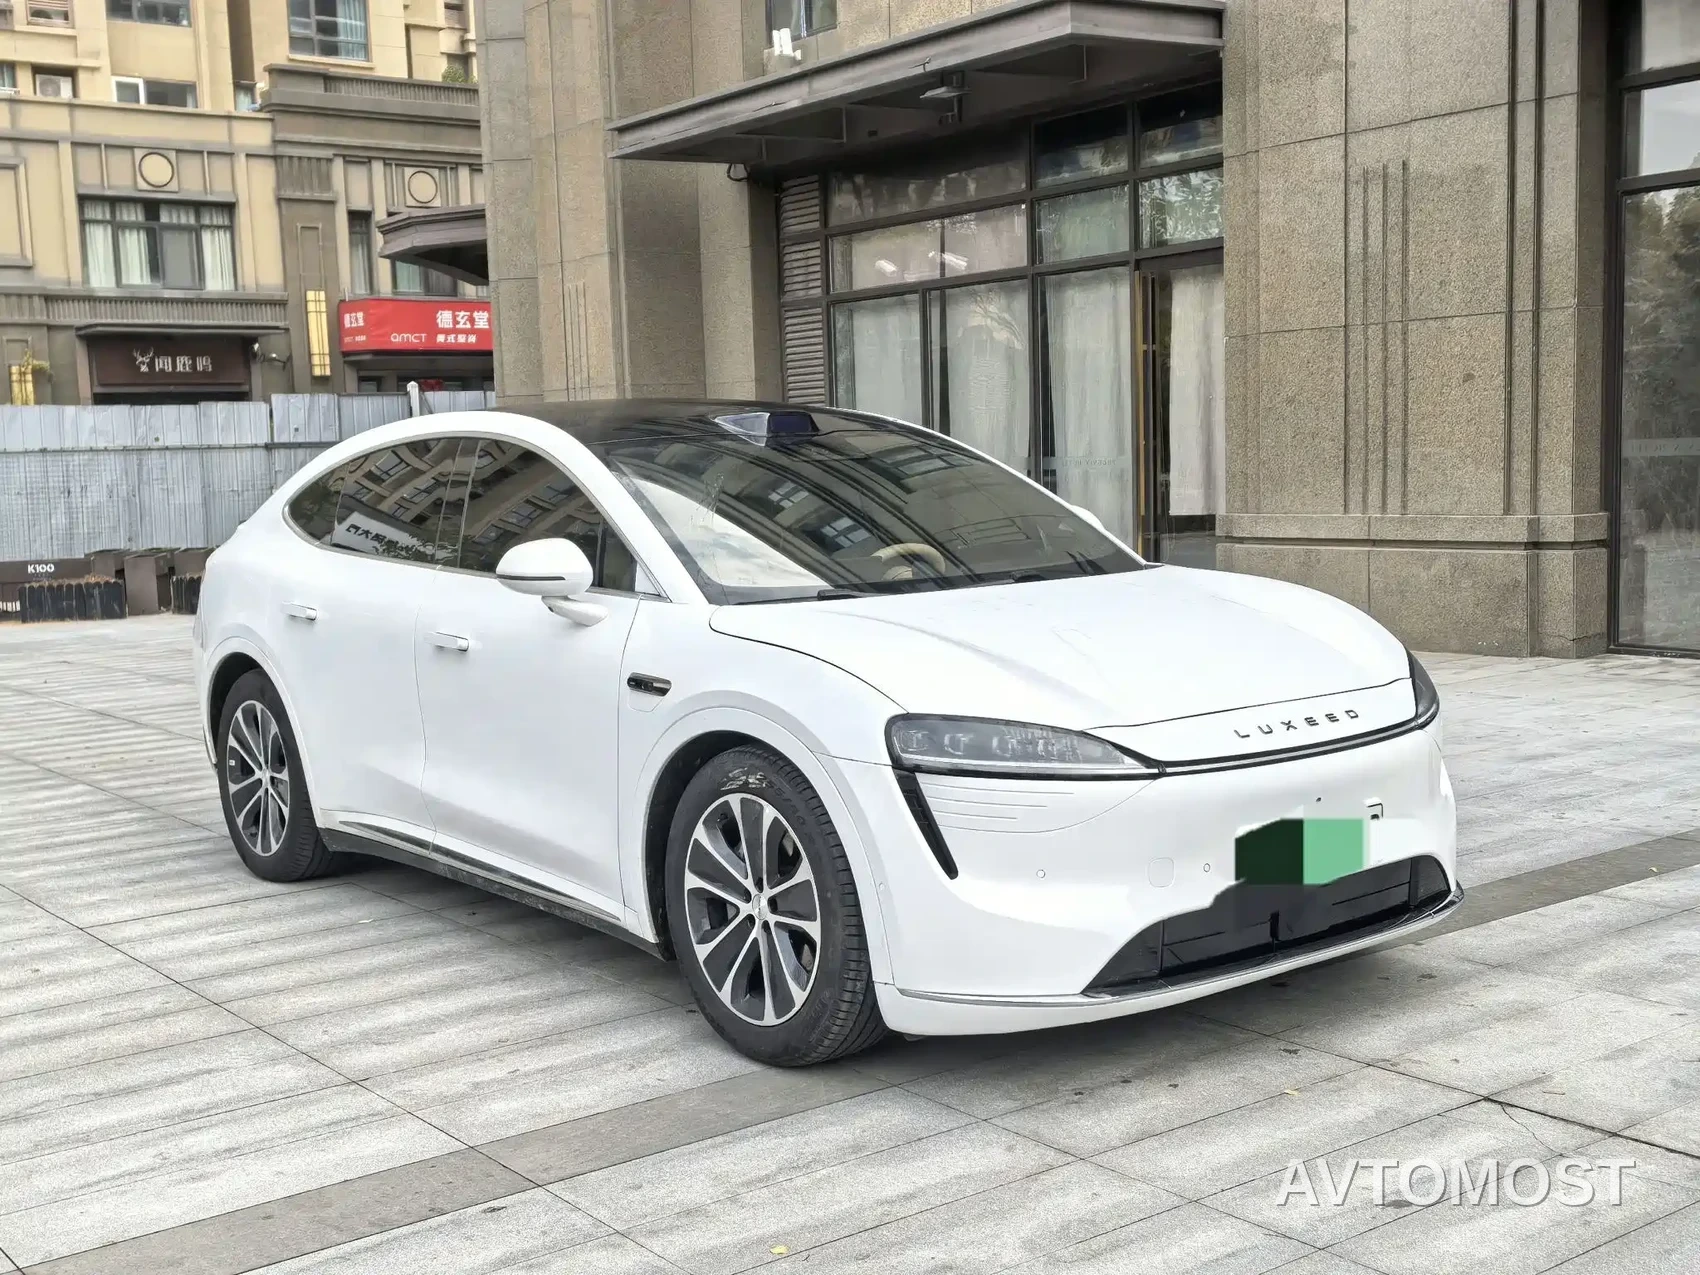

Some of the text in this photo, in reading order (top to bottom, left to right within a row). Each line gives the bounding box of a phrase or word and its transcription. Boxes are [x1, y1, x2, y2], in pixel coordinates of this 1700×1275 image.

[436, 310, 490, 329] 德玄堂
[27, 563, 55, 574] K100
[1233, 709, 1359, 738] LUXEED
